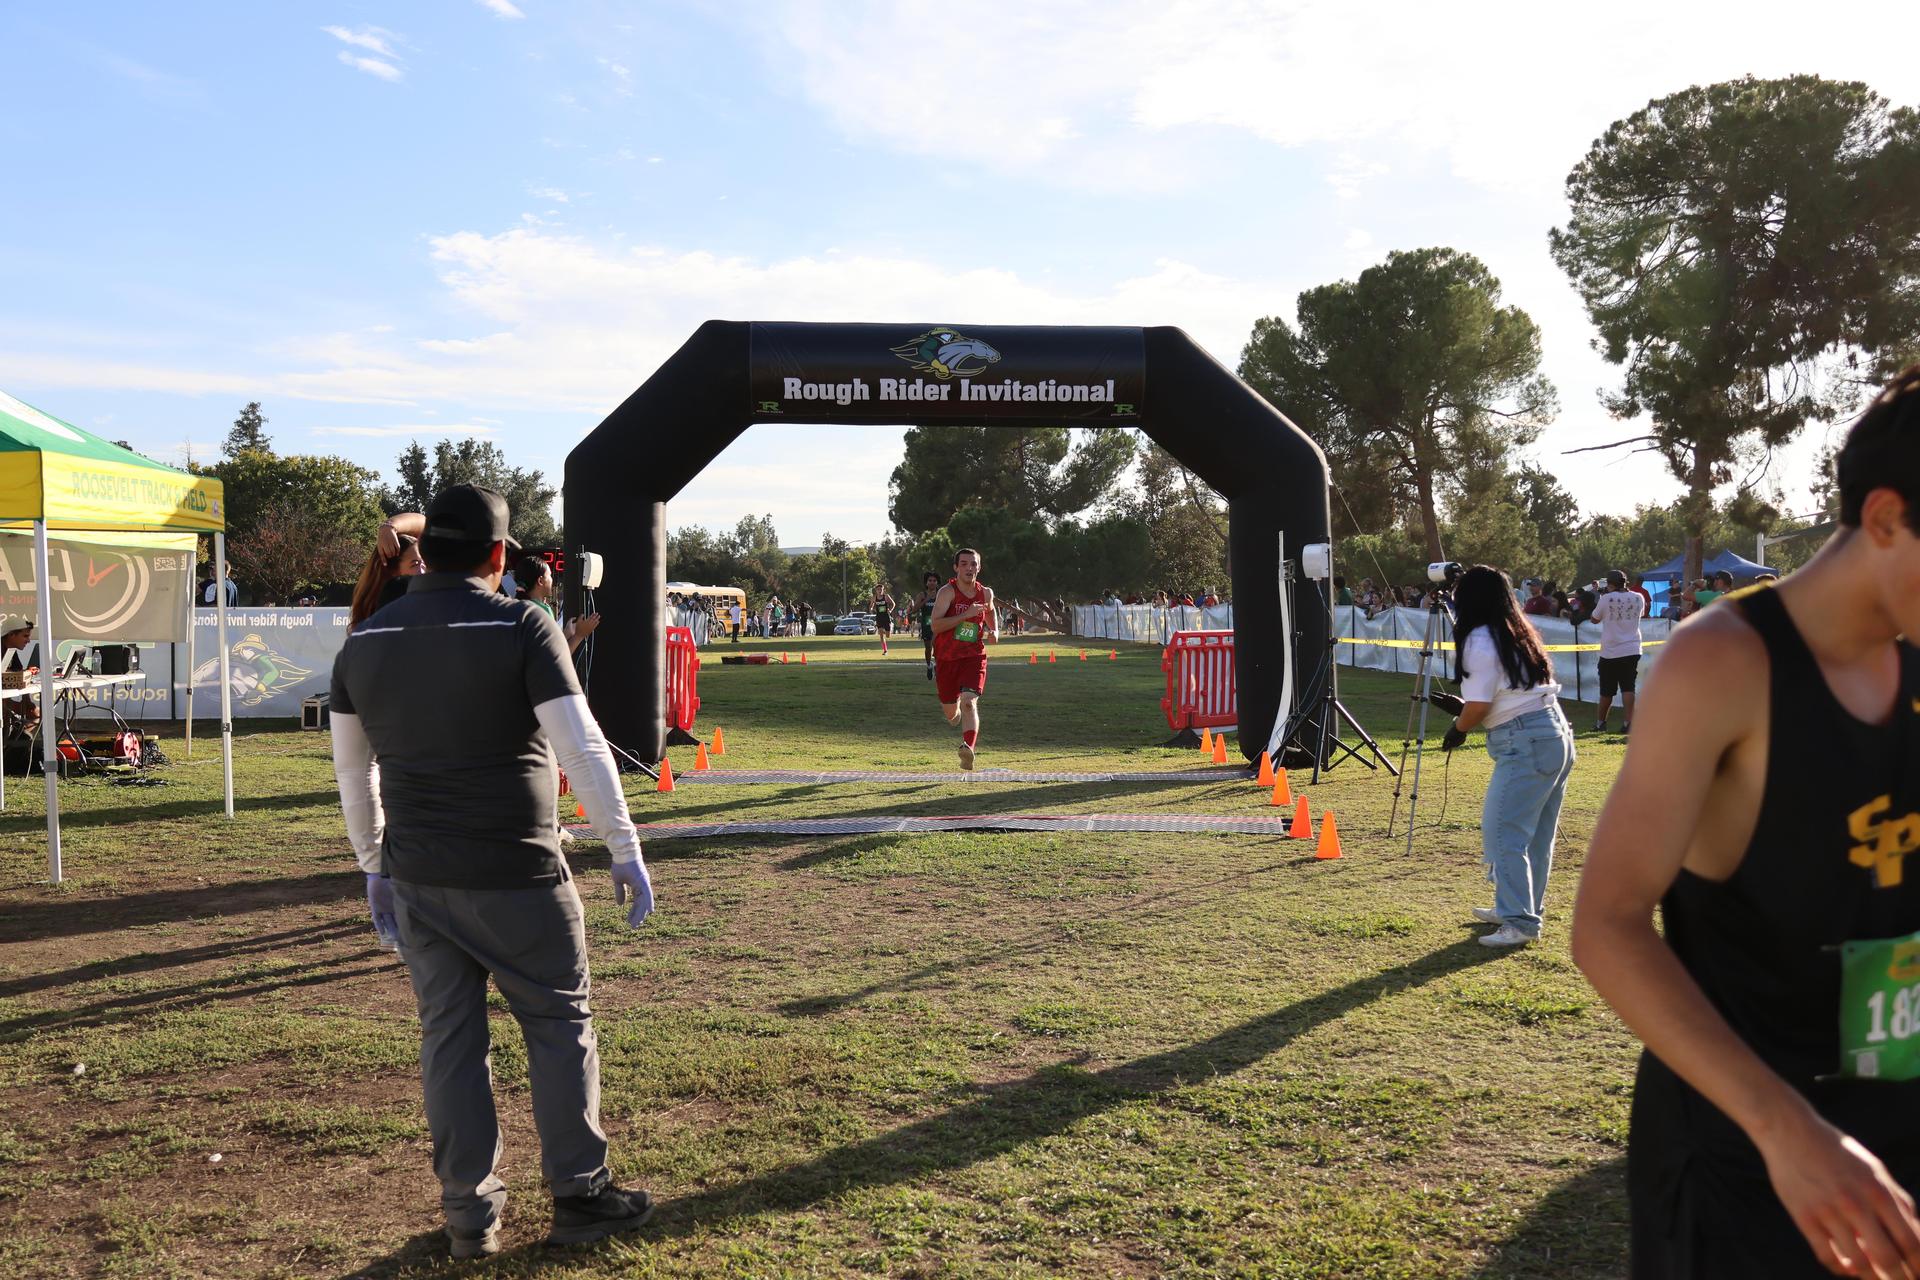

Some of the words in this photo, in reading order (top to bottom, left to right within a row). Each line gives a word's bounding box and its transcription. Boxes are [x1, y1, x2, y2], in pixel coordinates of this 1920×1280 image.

[784, 377, 870, 406] Rough
[880, 378, 951, 401] Rider
[960, 378, 1115, 402] Invitational
[72, 471, 138, 502] ROOSEVELT
[140, 479, 172, 505] TRACK
[182, 486, 208, 512] FIELD
